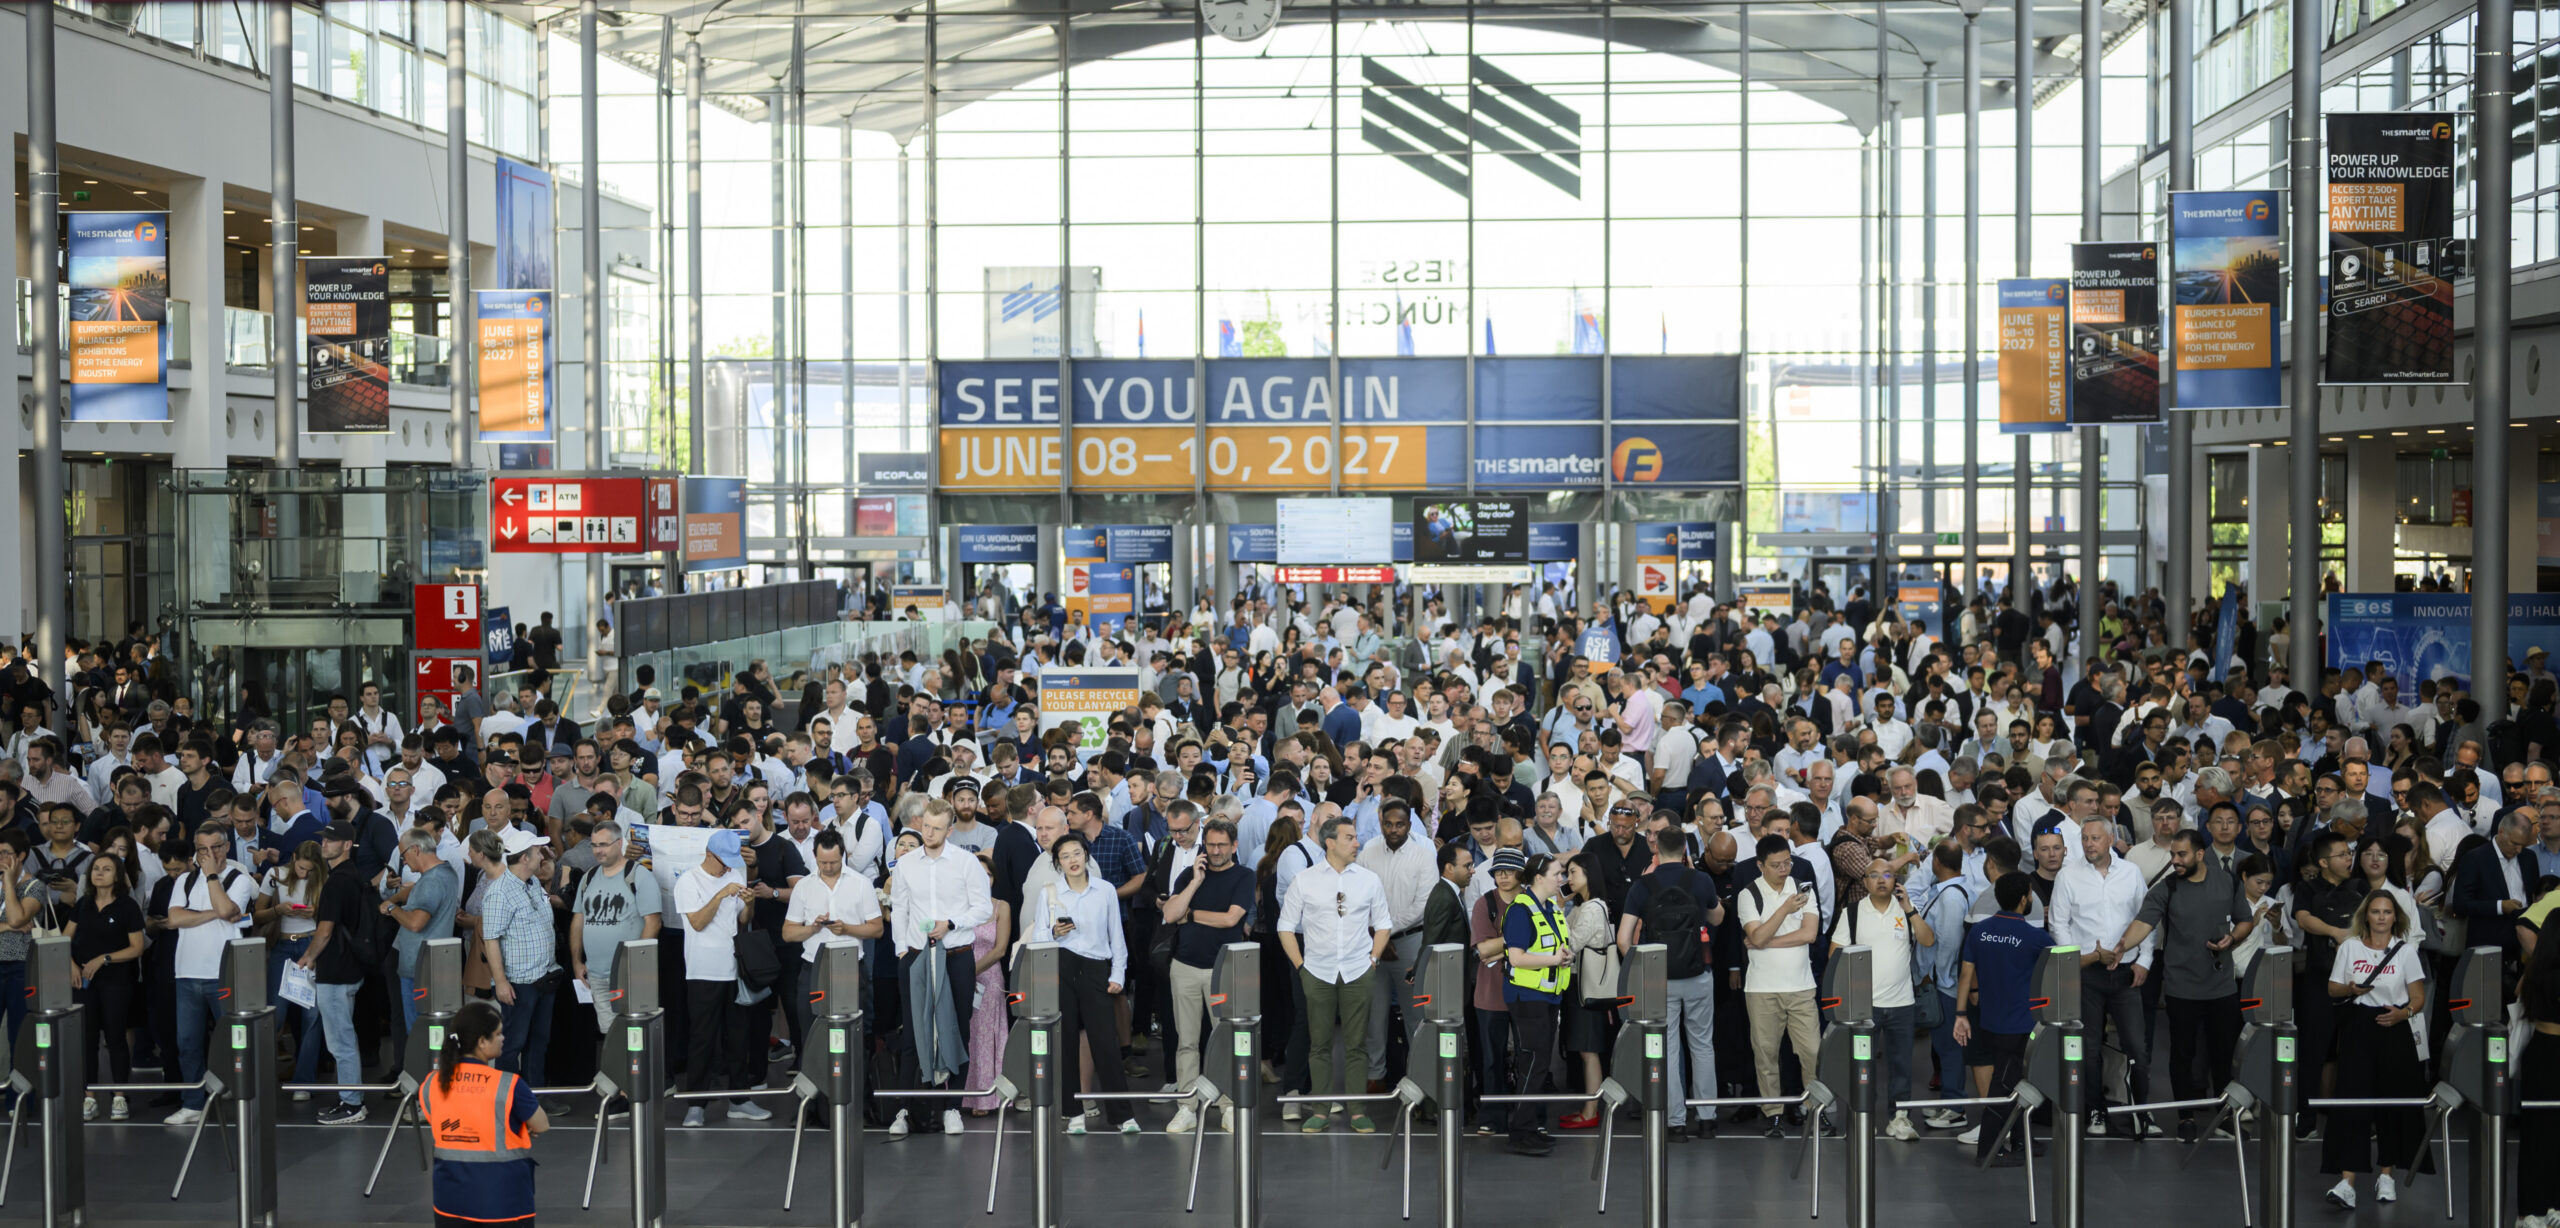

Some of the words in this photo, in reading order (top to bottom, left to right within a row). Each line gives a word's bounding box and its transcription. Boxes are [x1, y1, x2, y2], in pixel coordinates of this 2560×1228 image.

[2330, 154, 2378, 166] POWER
[2381, 154, 2399, 166] UP
[2330, 166, 2365, 178] YOUR
[2368, 166, 2449, 178] KNOWLEDGE
[2331, 185, 2365, 194] ACCESS
[2367, 185, 2397, 195] 2,500+
[2331, 196, 2366, 204] EXPERT
[2369, 196, 2396, 204] TALKS
[2331, 206, 2397, 218] ANYTIME
[2331, 220, 2397, 230] ANYWHERE
[2074, 270, 2106, 278] POWER
[2108, 270, 2121, 278] UP
[2074, 279, 2098, 287] YOUR
[2099, 277, 2155, 287] KNOWLEDGE
[309, 284, 340, 292] POWER
[340, 284, 353, 292] UP
[309, 292, 332, 300] YOUR
[333, 292, 385, 300] KNOWLEDGE
[2354, 294, 2387, 308] SEARCH
[2075, 305, 2120, 313] ANYTIME
[2184, 309, 2225, 318] EUROPE'S
[2227, 307, 2264, 316] LARGEST
[310, 318, 352, 326] ANYTIME
[2003, 314, 2035, 326] JUNE
[2184, 320, 2223, 329] ALLIANCE
[2225, 320, 2236, 328] OF
[78, 325, 116, 334] EUROPE'S
[117, 325, 152, 334] LARGEST
[484, 325, 514, 337] JUNE
[2047, 313, 2060, 349] DATE
[78, 336, 115, 345] ALLIANCE
[115, 336, 127, 345] OF
[2184, 331, 2238, 341] EXHIBITIONS
[527, 325, 539, 359] DATE
[2003, 338, 2034, 350] 2027
[2185, 344, 2202, 352] FOR
[2204, 343, 2220, 351] THE
[2222, 342, 2256, 352] ENERGY
[78, 347, 127, 356] EXHIBITIONS
[484, 349, 515, 360] 2027
[78, 358, 94, 367] FOR
[96, 358, 112, 367] THE
[112, 358, 144, 367] ENERGY
[2185, 354, 2227, 363] INDUSTRY
[2048, 351, 2061, 378] THE
[2092, 363, 2114, 373] SEARCH
[78, 369, 117, 377] INDUSTRY
[527, 362, 539, 388] THE
[325, 373, 347, 385] SEARCH
[955, 377, 1060, 423] SEE
[1082, 376, 1195, 422] YOU
[1220, 375, 1399, 420] AGAIN
[2049, 381, 2061, 415] SAVE
[528, 391, 540, 424] SAVE
[955, 436, 1061, 480] JUNE
[1267, 436, 1399, 476] 2027
[558, 493, 578, 501] ATM
[1477, 502, 1498, 510] Trade
[1499, 502, 1511, 510] fair
[1477, 511, 1491, 519] day
[1492, 510, 1515, 518] done?
[1114, 529, 1139, 537] NORTH
[1140, 529, 1171, 537] AMERICA
[1250, 528, 1275, 536] SOUTH
[975, 534, 985, 543] US
[987, 534, 1036, 543] WORLDWIDE
[1477, 550, 1495, 558] Uber
[2354, 601, 2392, 614] ees
[488, 627, 509, 640] ASK
[489, 636, 512, 652] ME
[1586, 636, 1610, 649] ASK
[1584, 647, 1610, 662] ME
[1046, 691, 1085, 700] PLEASE
[1088, 691, 1134, 700] RECYCLE
[1046, 701, 1075, 710] YOUR
[1078, 701, 1127, 710] LANYARD
[1980, 931, 2022, 948] Security
